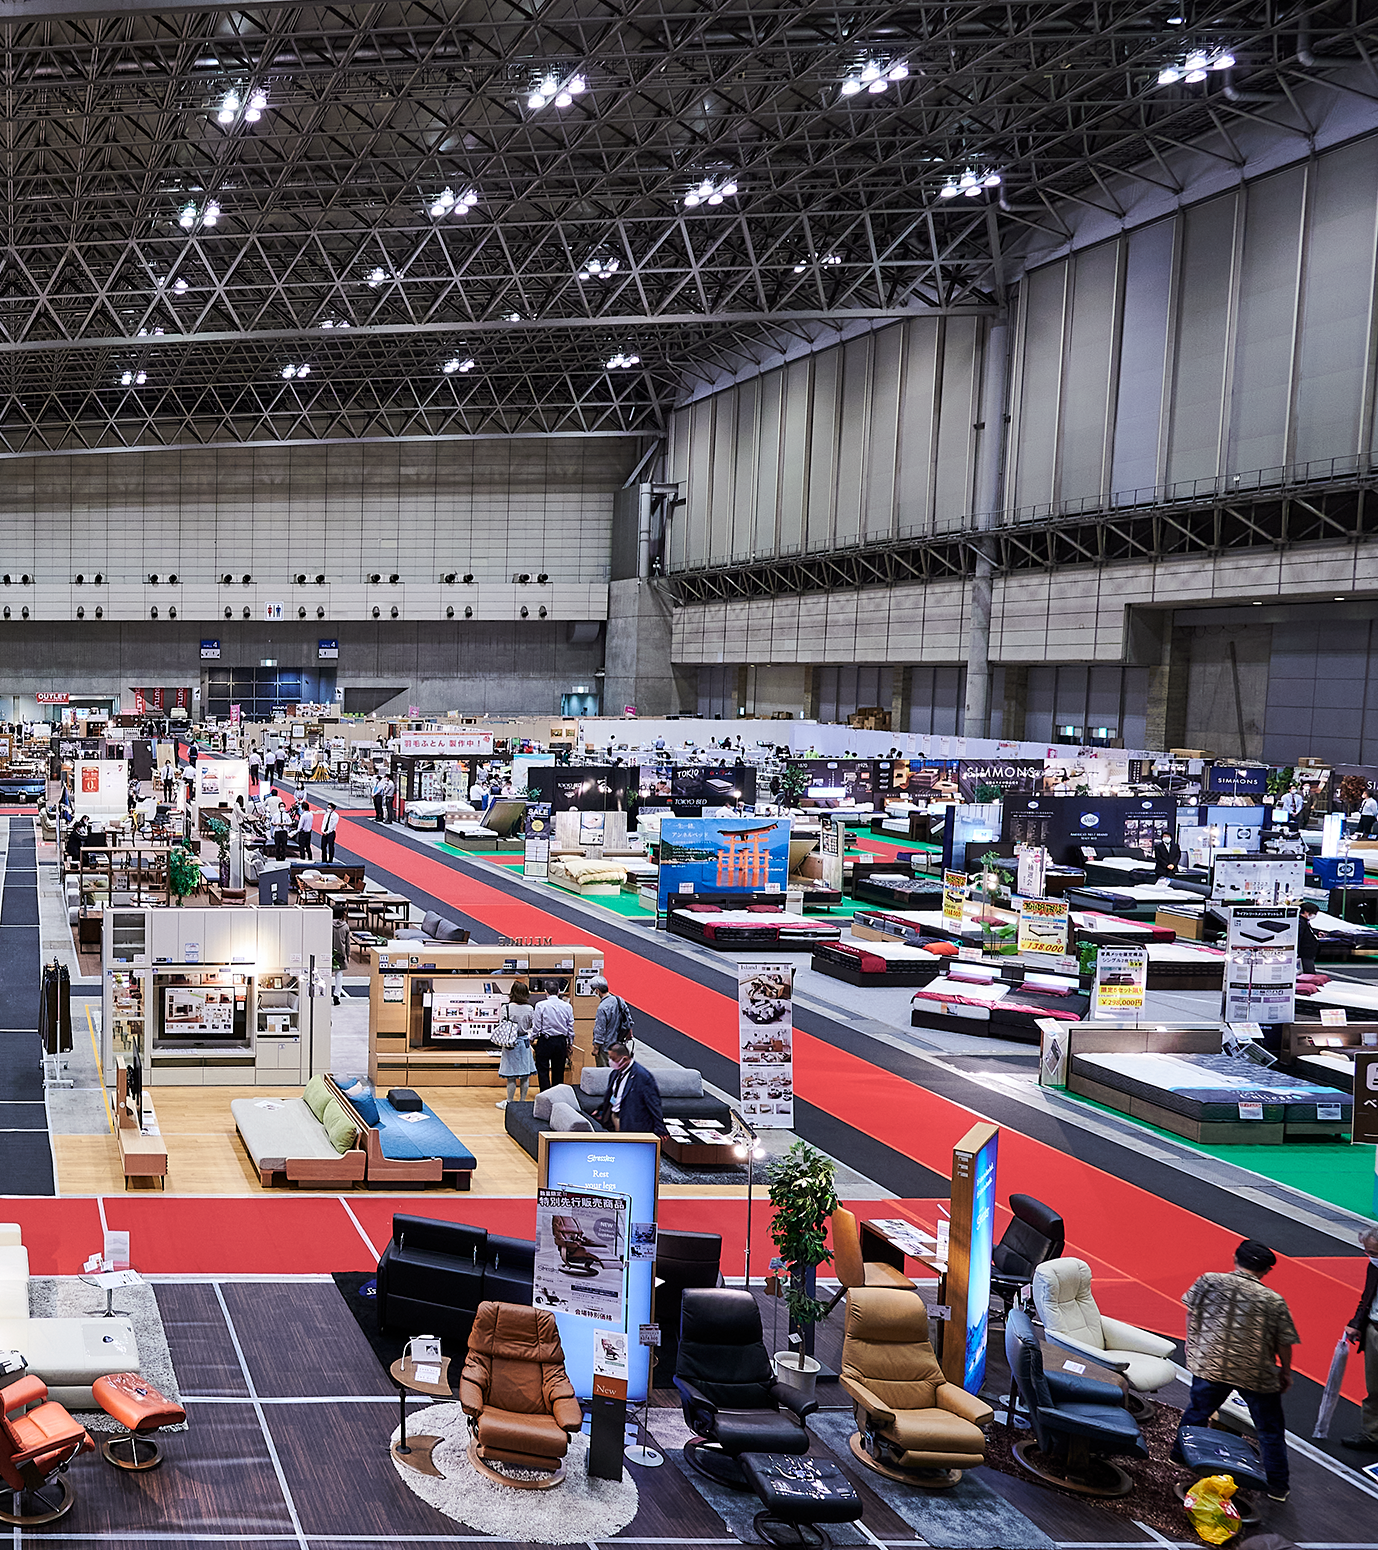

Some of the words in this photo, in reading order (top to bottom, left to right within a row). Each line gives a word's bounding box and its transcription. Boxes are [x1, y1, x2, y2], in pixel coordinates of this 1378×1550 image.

[404, 740, 446, 748] 羽毛ふとん
[630, 757, 637, 765] 15
[676, 769, 700, 779] TOKIO
[966, 766, 1035, 778] SIMMONS
[1217, 777, 1259, 785] SIMMONS
[674, 798, 694, 806] TOKYO
[528, 808, 549, 816] SALE
[592, 1169, 609, 1178] Rest
[584, 1183, 602, 1191] your
[602, 1181, 616, 1191] legs
[539, 1196, 626, 1210] 特別先行販売商品
[575, 1308, 613, 1322] 会場特別価格
[596, 1384, 617, 1395] New
